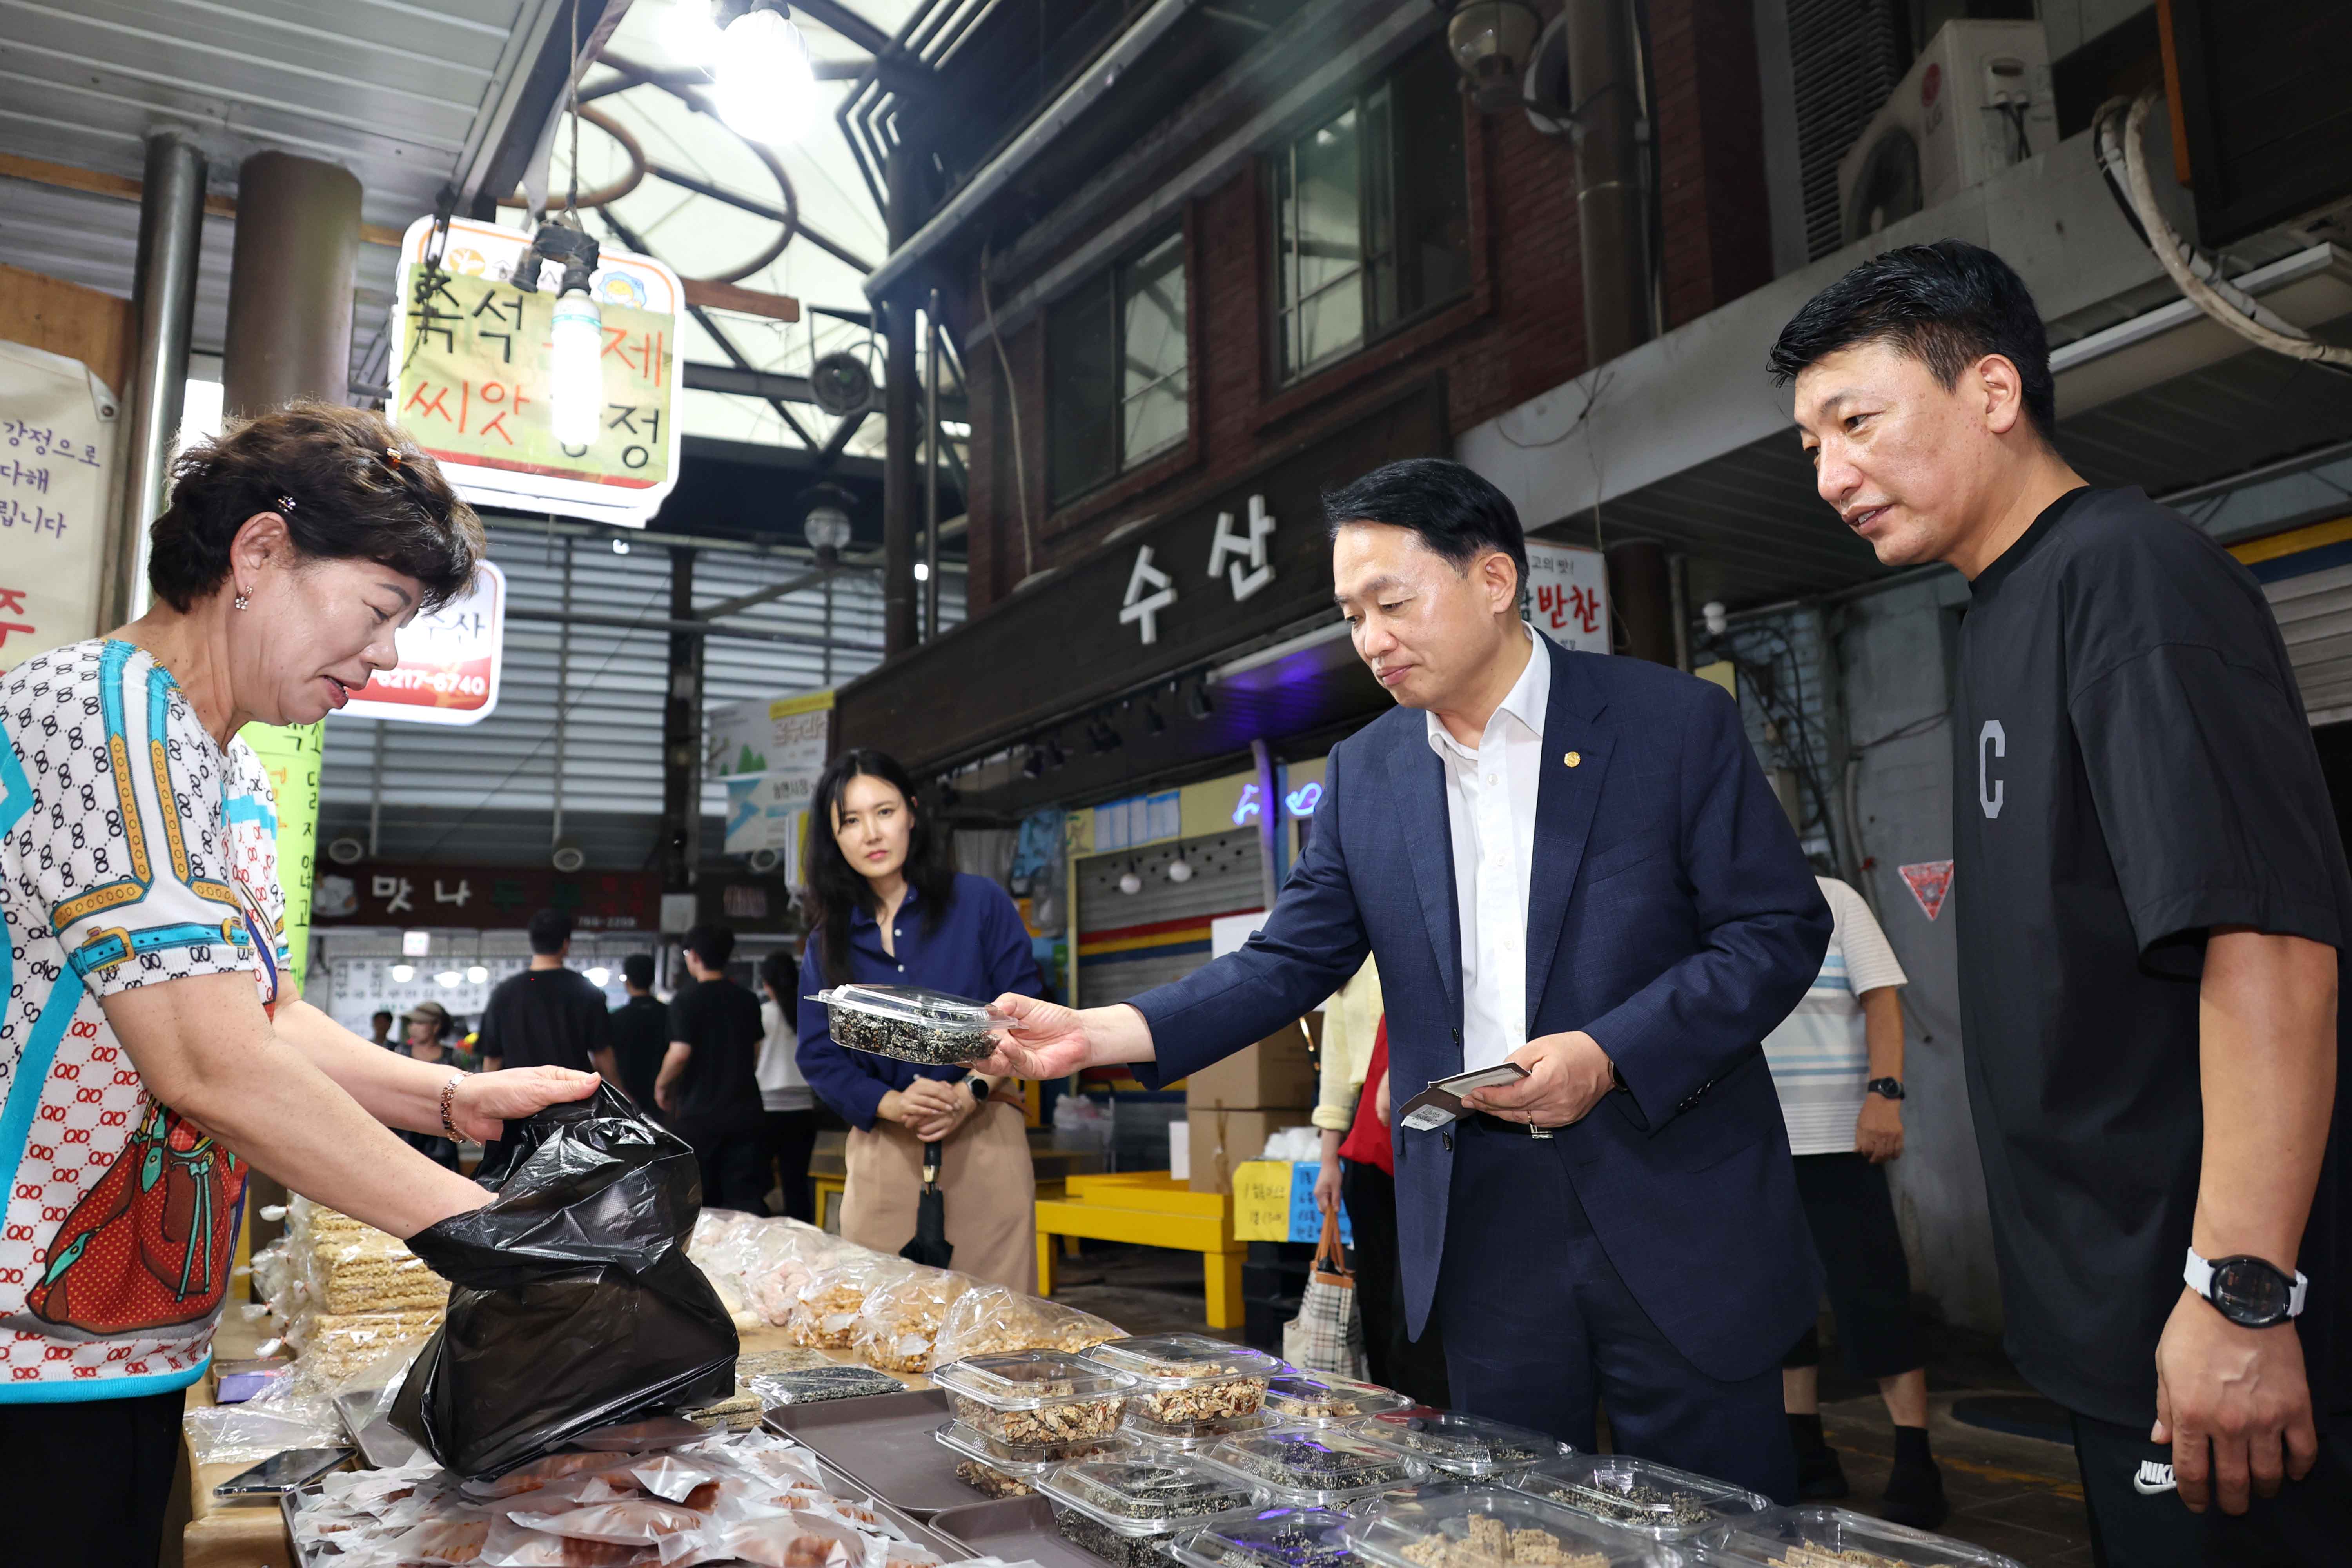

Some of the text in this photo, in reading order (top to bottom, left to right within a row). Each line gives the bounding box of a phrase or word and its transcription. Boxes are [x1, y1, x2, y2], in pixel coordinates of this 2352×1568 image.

[404, 380, 530, 446] 씨앗
[3, 419, 100, 468] 강정으로
[0, 459, 49, 494] 다해
[1119, 494, 1276, 645] 수산
[1537, 583, 1601, 633] 반찬
[1979, 720, 2005, 819] C
